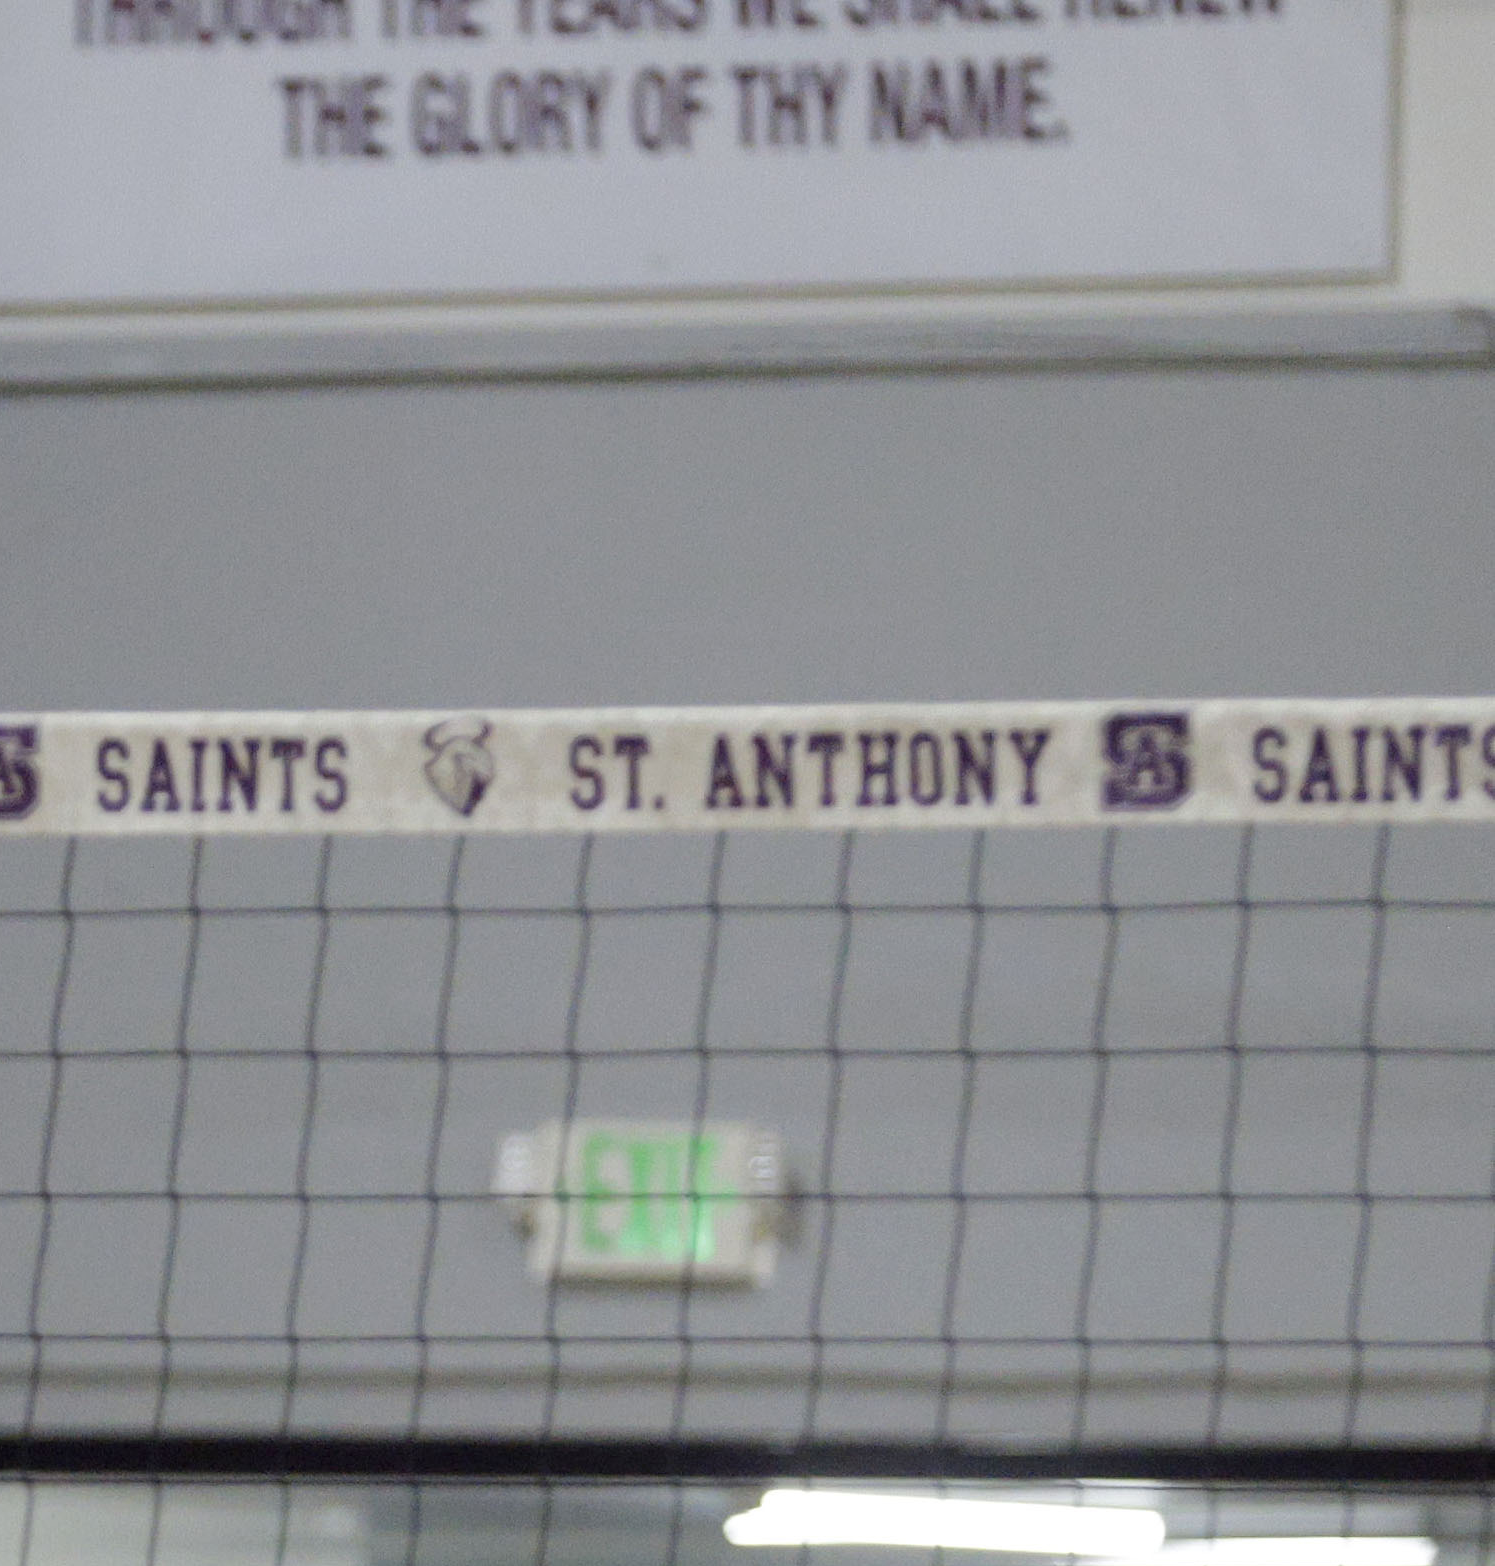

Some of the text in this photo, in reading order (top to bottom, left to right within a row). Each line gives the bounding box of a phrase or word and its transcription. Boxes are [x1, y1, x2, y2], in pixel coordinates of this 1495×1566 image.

[278, 56, 1070, 157] THE GLORY OF THY NAME.
[96, 736, 348, 814] SAINTS
[568, 733, 665, 812] ST.
[704, 728, 1052, 810] ANTHONY
[582, 1130, 724, 1262] EXIT
